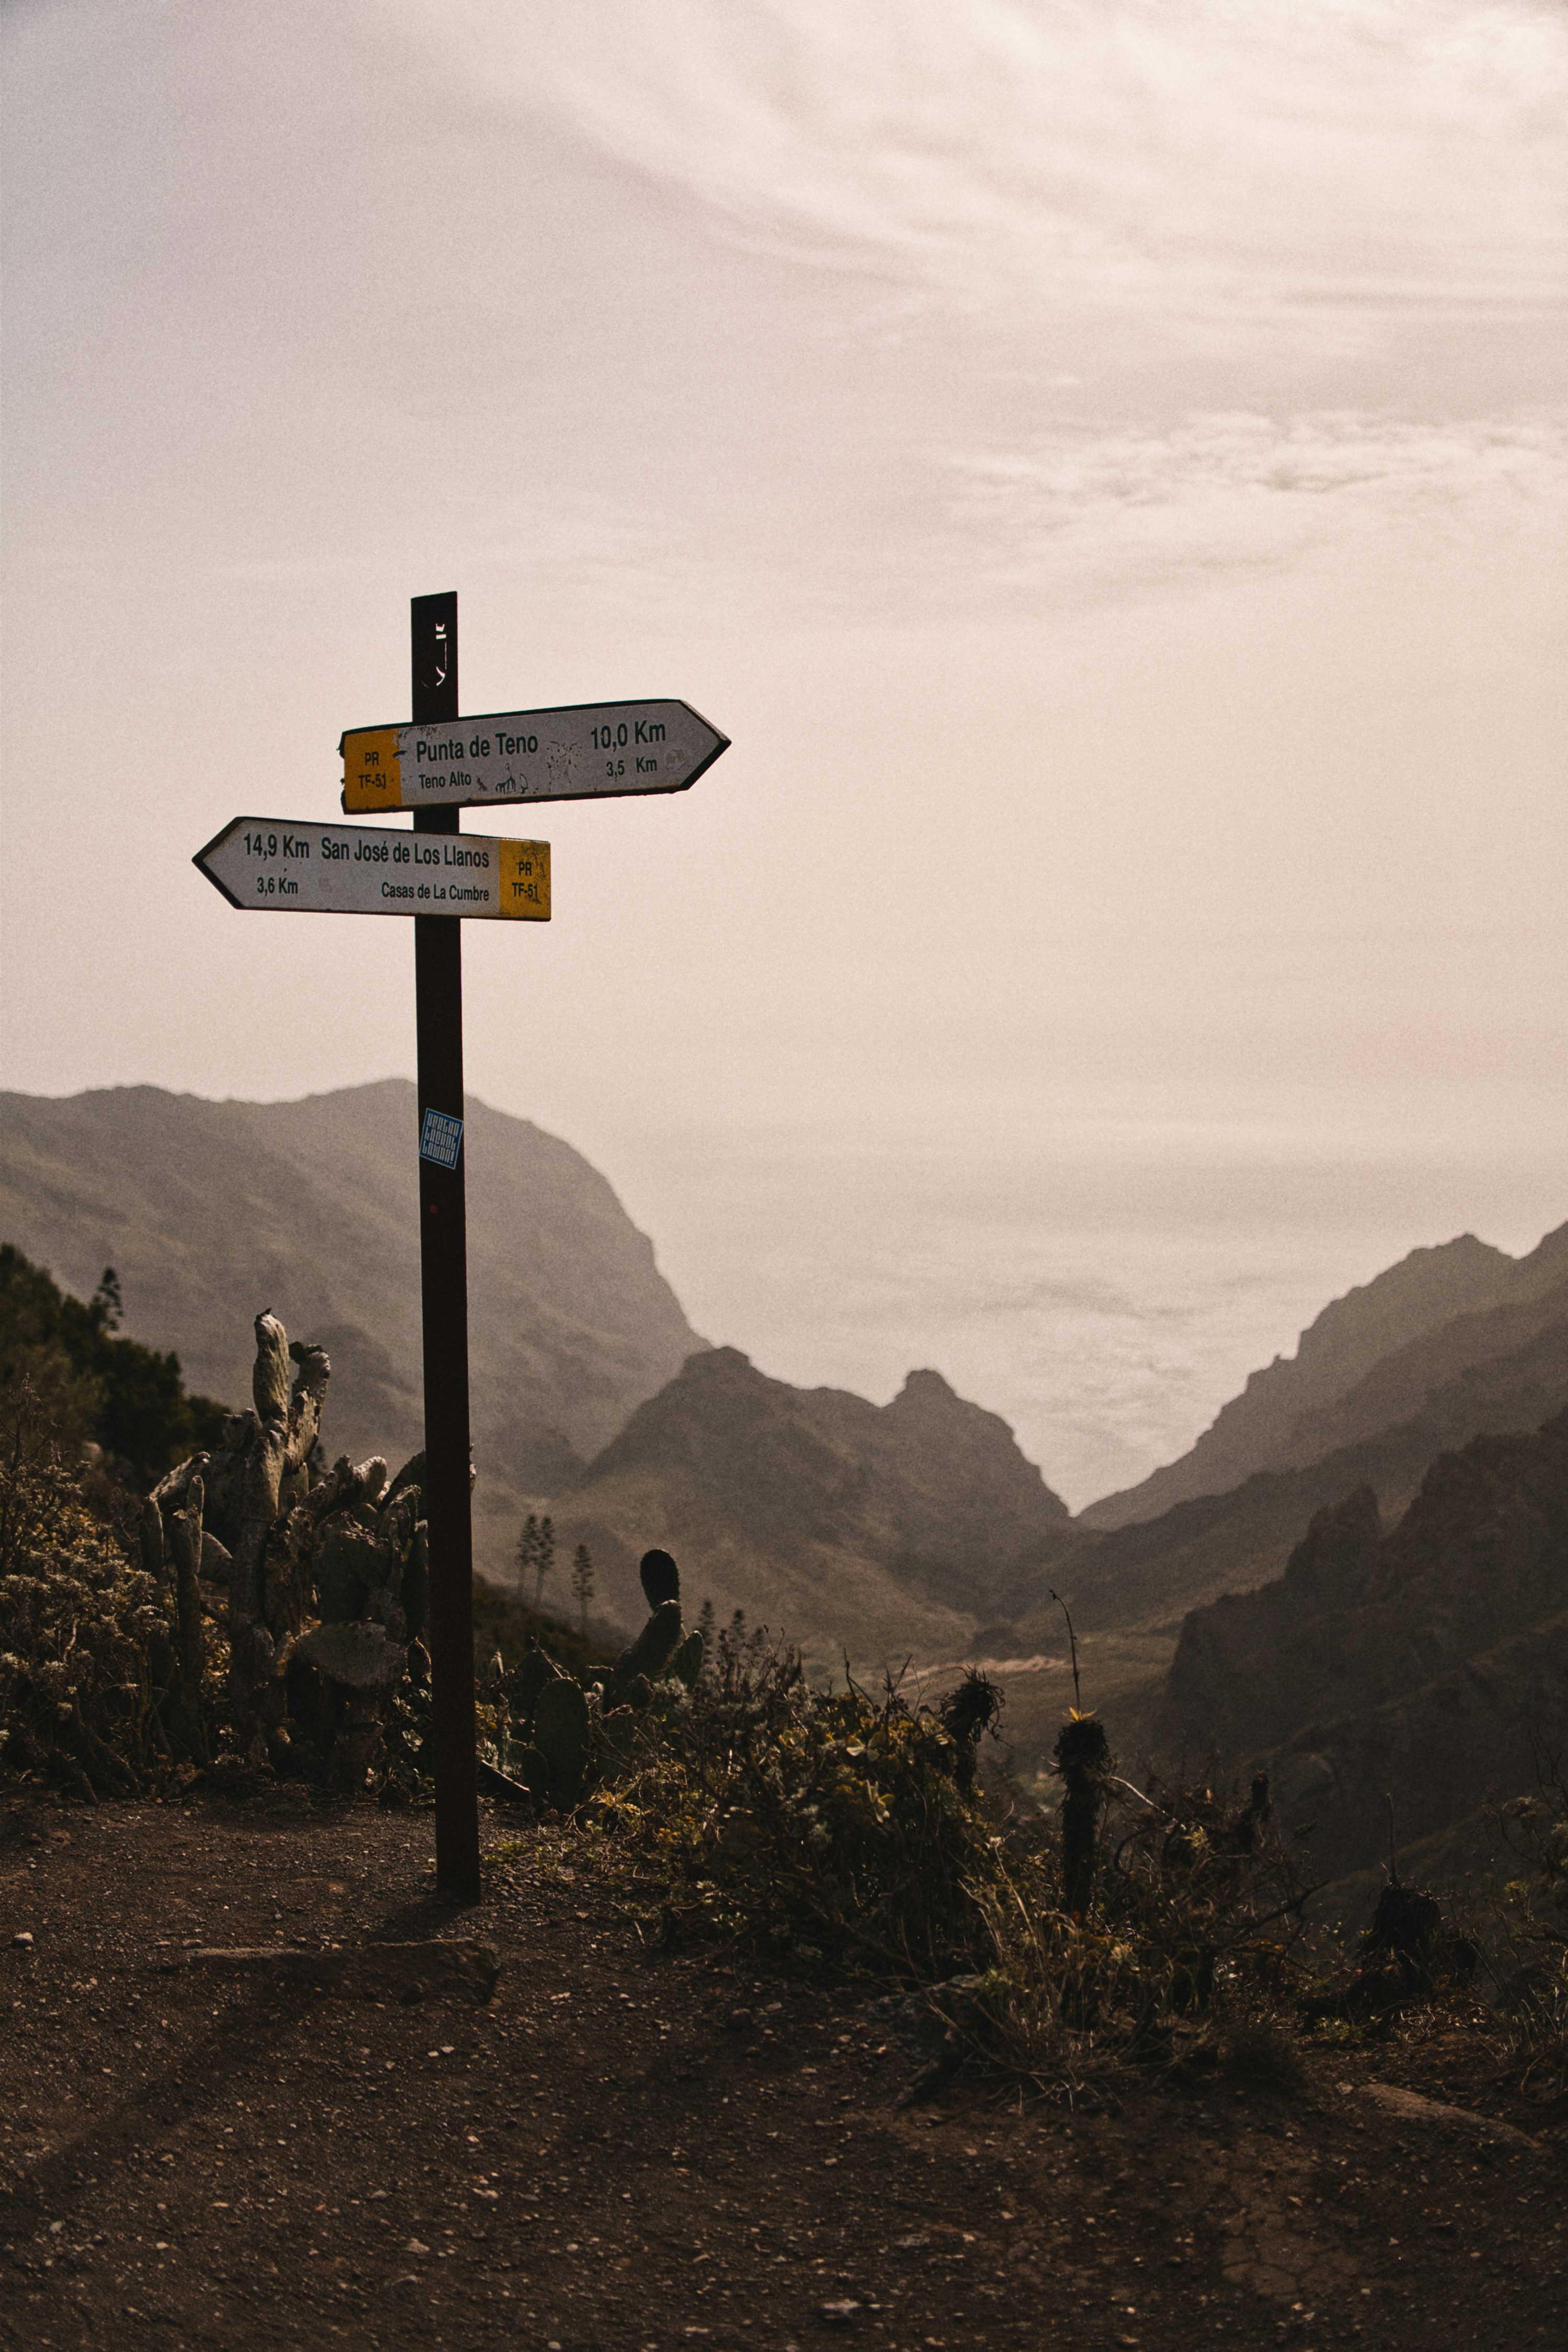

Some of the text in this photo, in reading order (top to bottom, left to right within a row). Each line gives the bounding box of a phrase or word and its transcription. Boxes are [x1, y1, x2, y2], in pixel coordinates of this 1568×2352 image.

[417, 720, 666, 763] Punta de Teno 10,0 Km
[365, 752, 379, 766] PR
[358, 773, 386, 789] TF-51
[419, 756, 657, 789] Teno Alto 3,5 Km
[244, 833, 489, 868] 14,9 Km San José de Los Llanos
[518, 861, 532, 876] PR
[257, 877, 489, 902] 3,6 Km Casas de La Cumbre
[512, 883, 538, 898] TF-51
